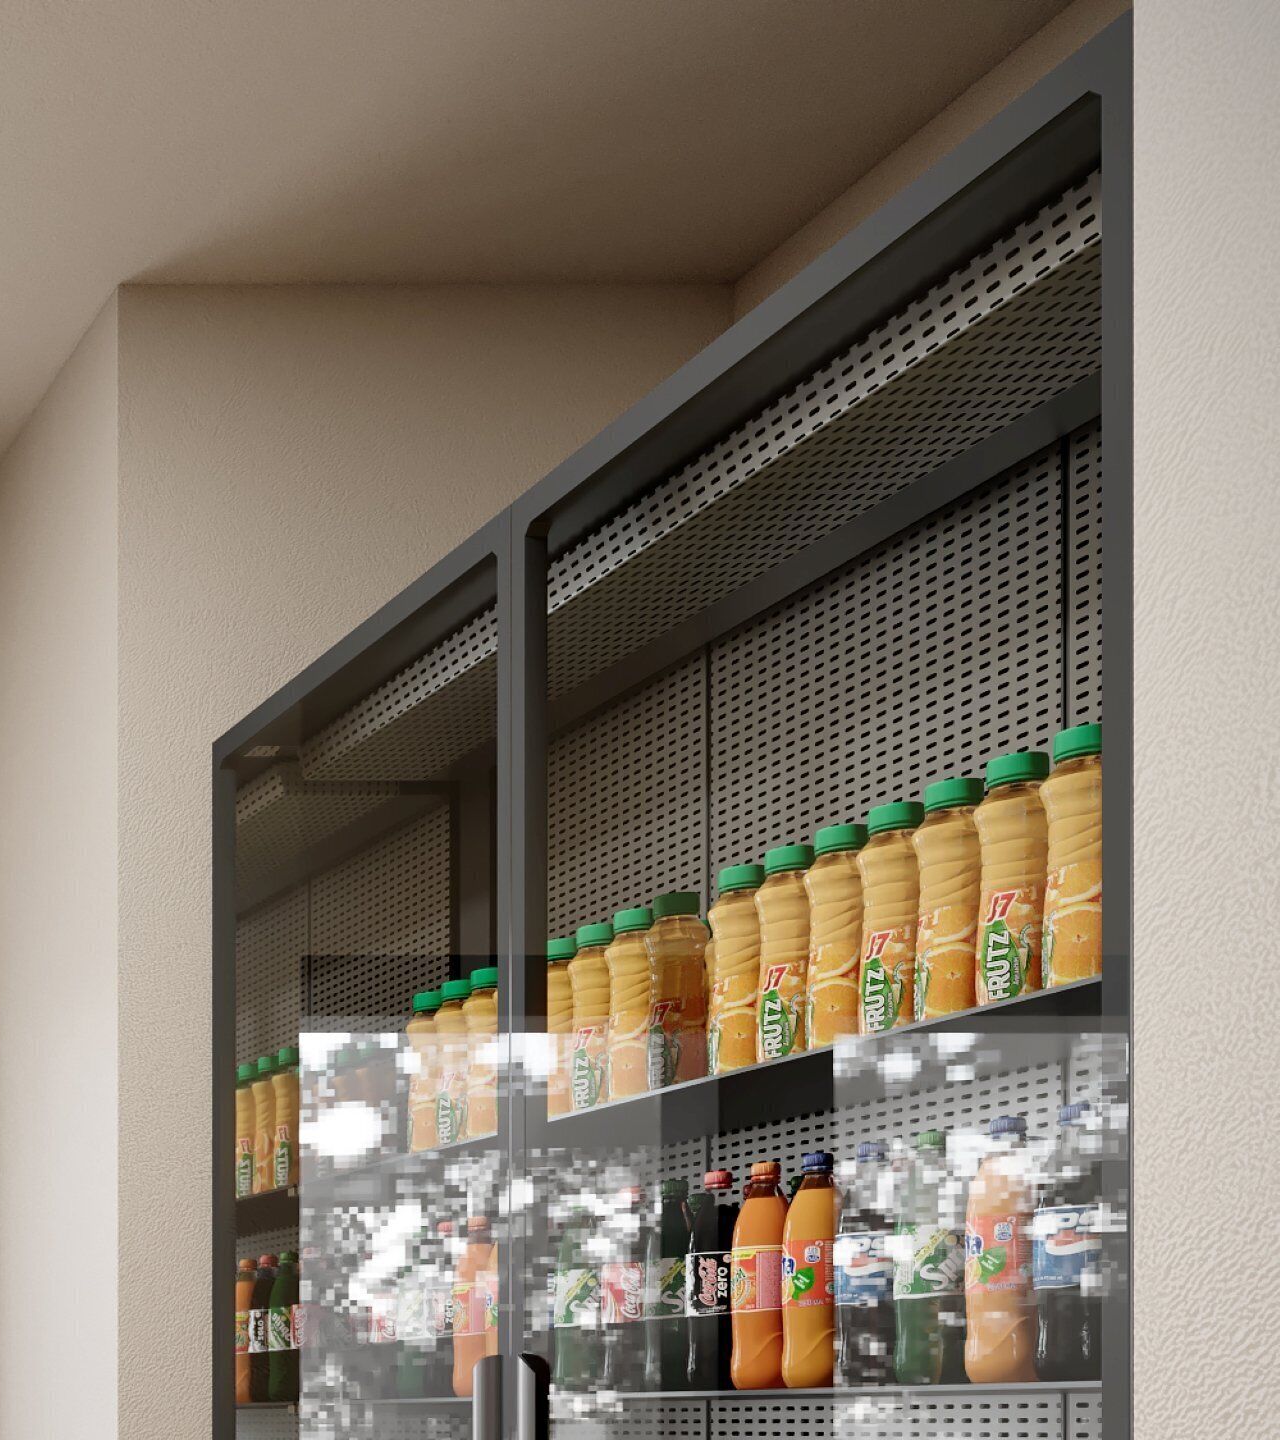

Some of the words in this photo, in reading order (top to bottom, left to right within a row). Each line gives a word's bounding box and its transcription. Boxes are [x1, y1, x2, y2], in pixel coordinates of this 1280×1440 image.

[986, 931, 1012, 1001] FRUTZ
[763, 998, 783, 1059] FRUTZ
[864, 968, 885, 1031] FRUTZ
[717, 1266, 729, 1299] zero
